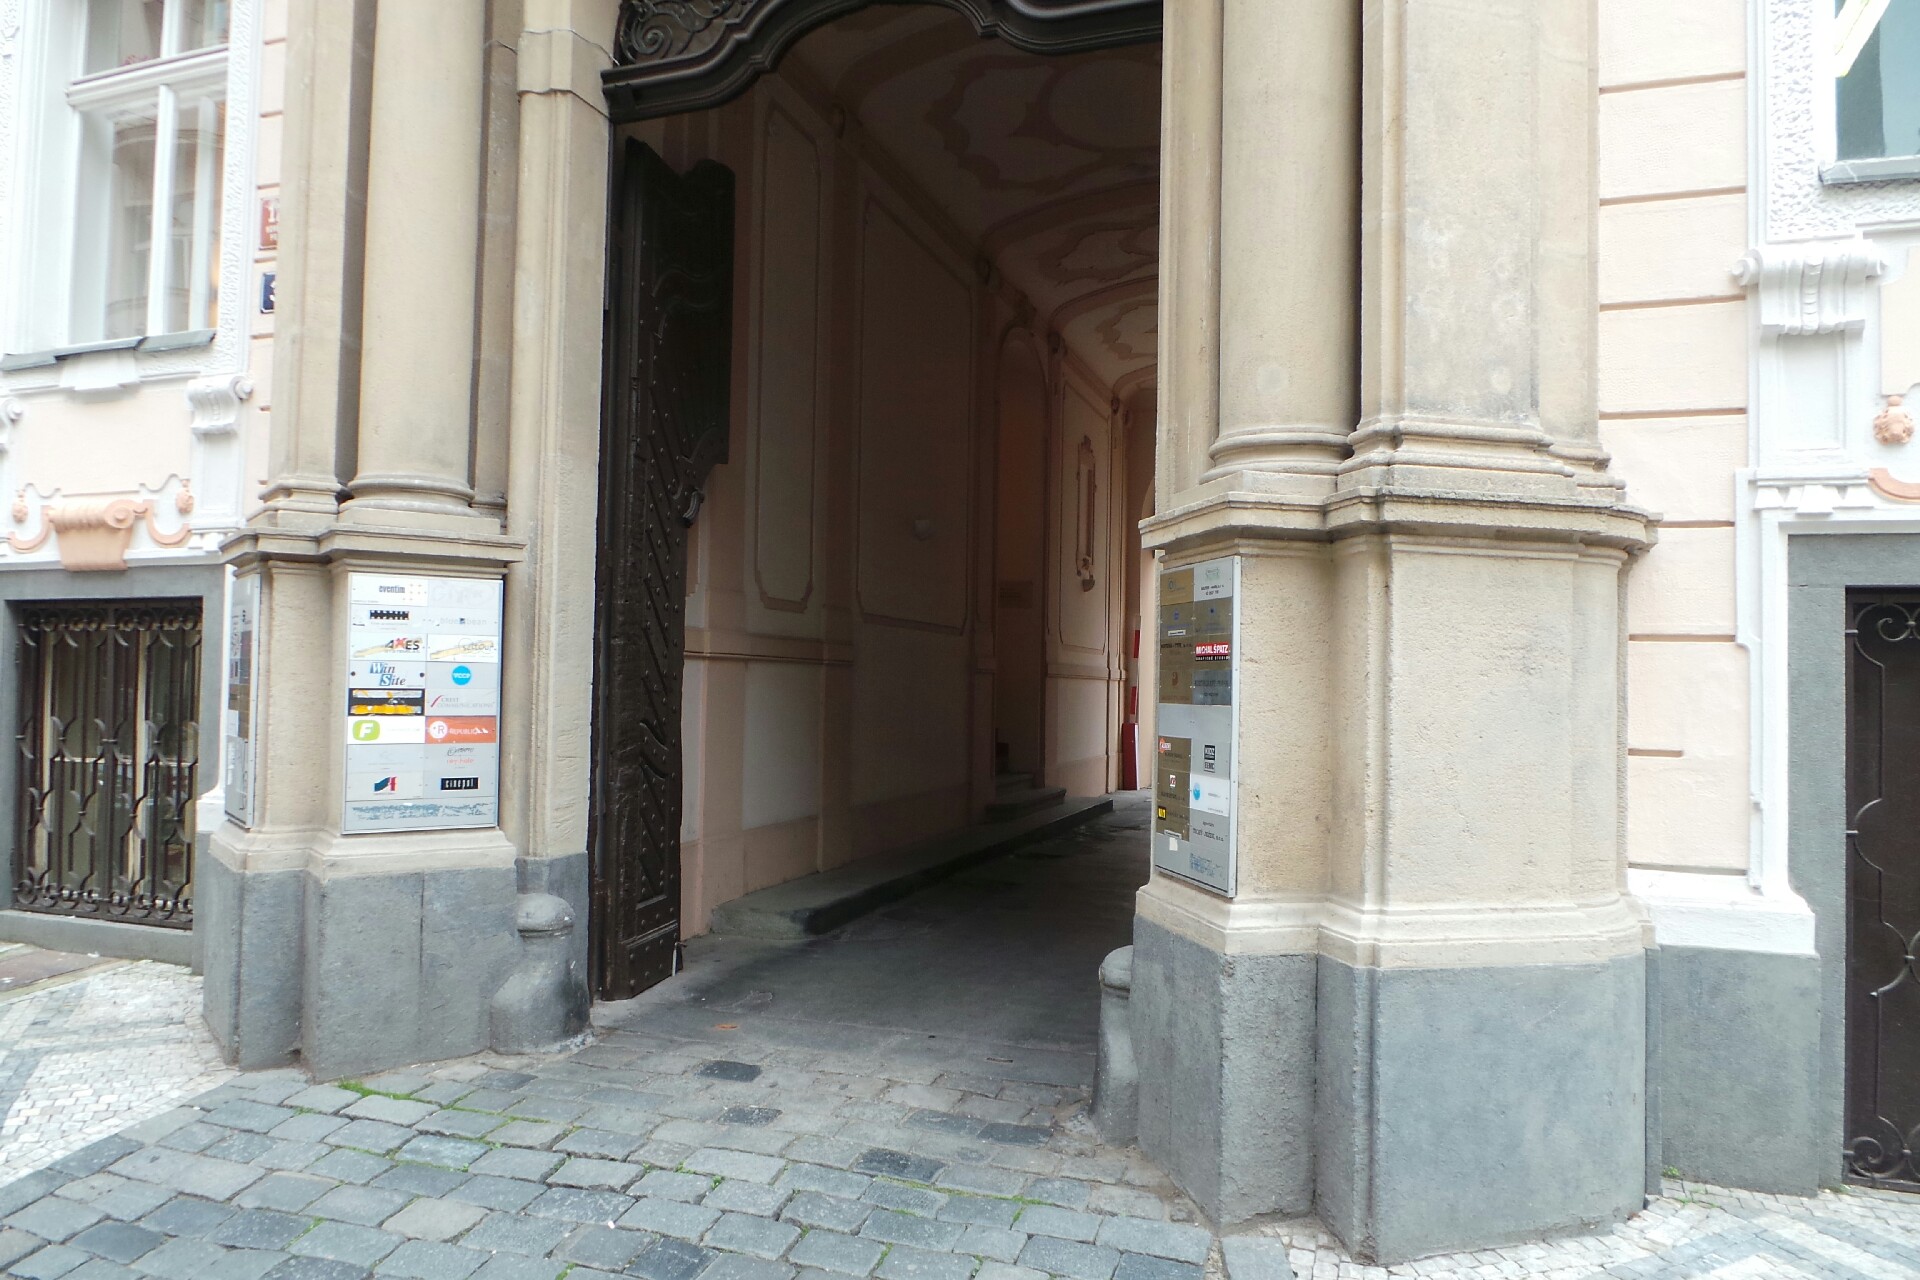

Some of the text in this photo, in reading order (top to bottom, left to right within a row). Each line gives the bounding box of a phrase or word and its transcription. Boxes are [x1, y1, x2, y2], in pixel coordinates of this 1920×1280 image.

[379, 584, 406, 594] eventim
[440, 617, 488, 626] blue bean
[385, 637, 420, 651] AXES
[1196, 644, 1229, 655] MICHAL ŠPATZ
[370, 662, 396, 674] Win
[380, 674, 406, 686] Site
